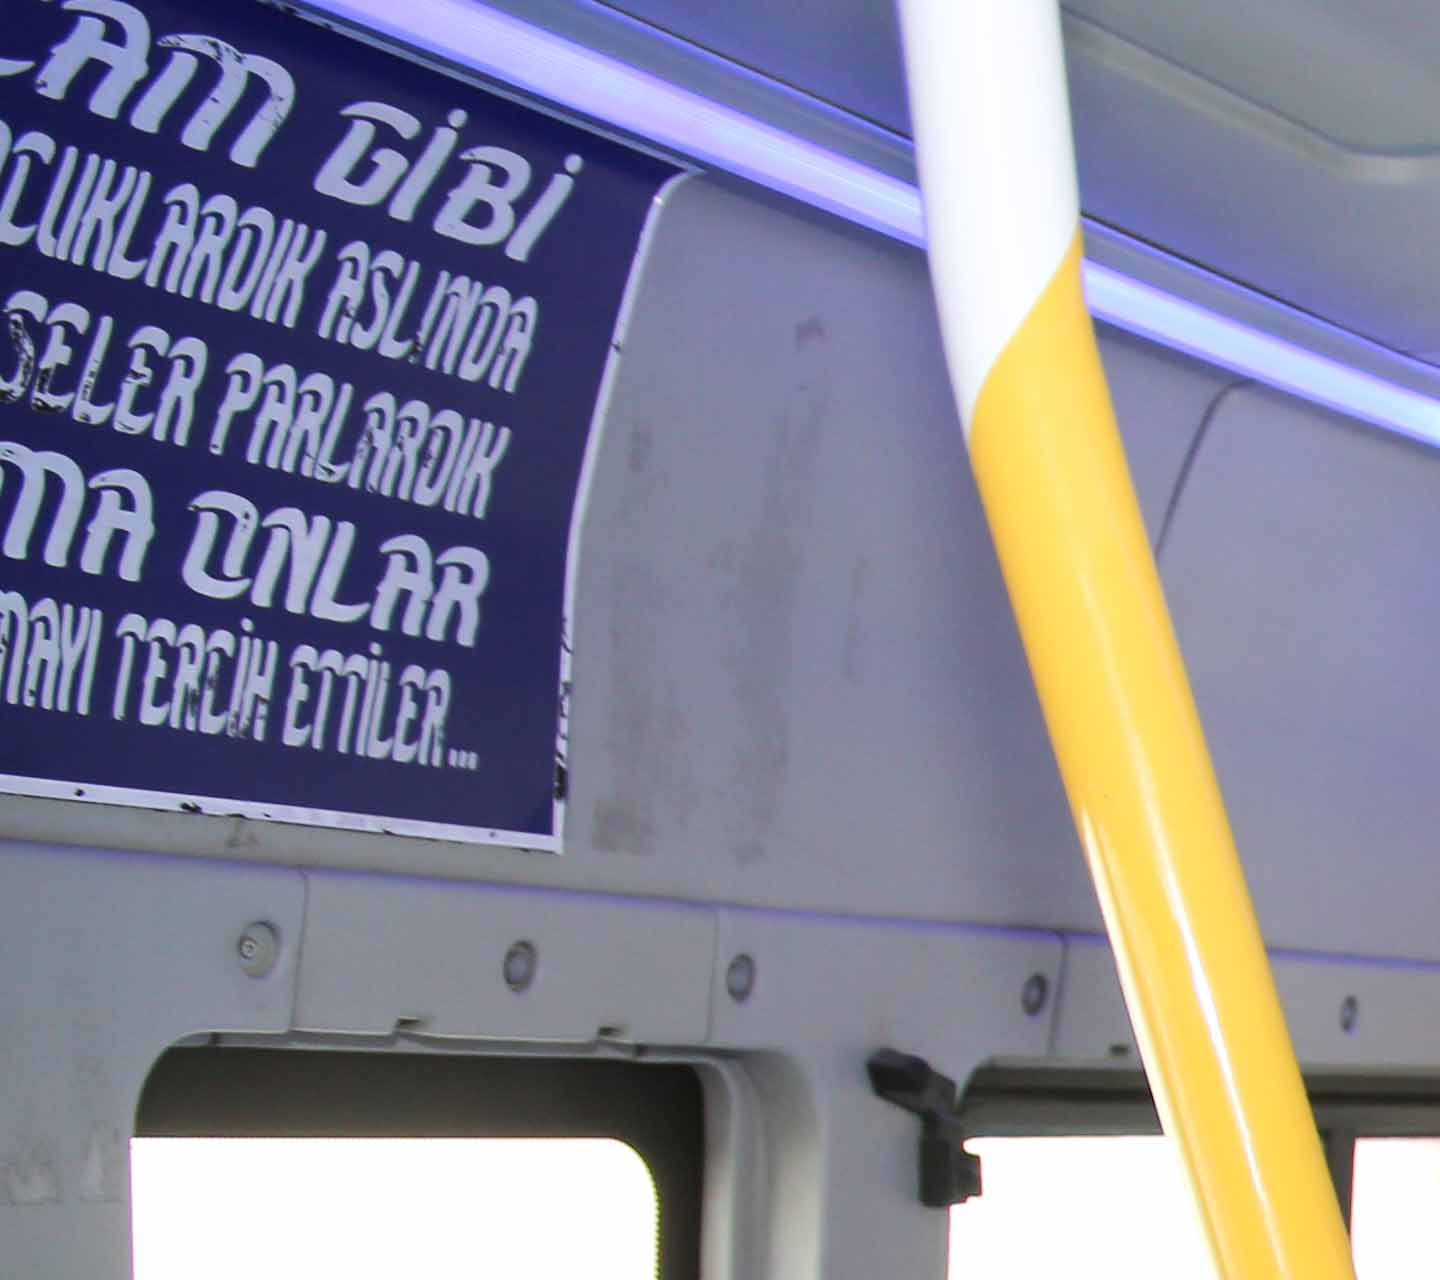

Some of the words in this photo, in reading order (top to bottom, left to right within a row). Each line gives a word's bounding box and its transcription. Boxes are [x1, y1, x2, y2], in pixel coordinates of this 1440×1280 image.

[0, 0, 296, 168] AM
[313, 101, 584, 263] GİBİ
[0, 119, 328, 329] CUKLARDIK
[317, 240, 539, 395] ASLINDA
[208, 352, 512, 520] PARLARDIK
[181, 490, 490, 648] ONLAR
[112, 613, 279, 742] TERCİH
